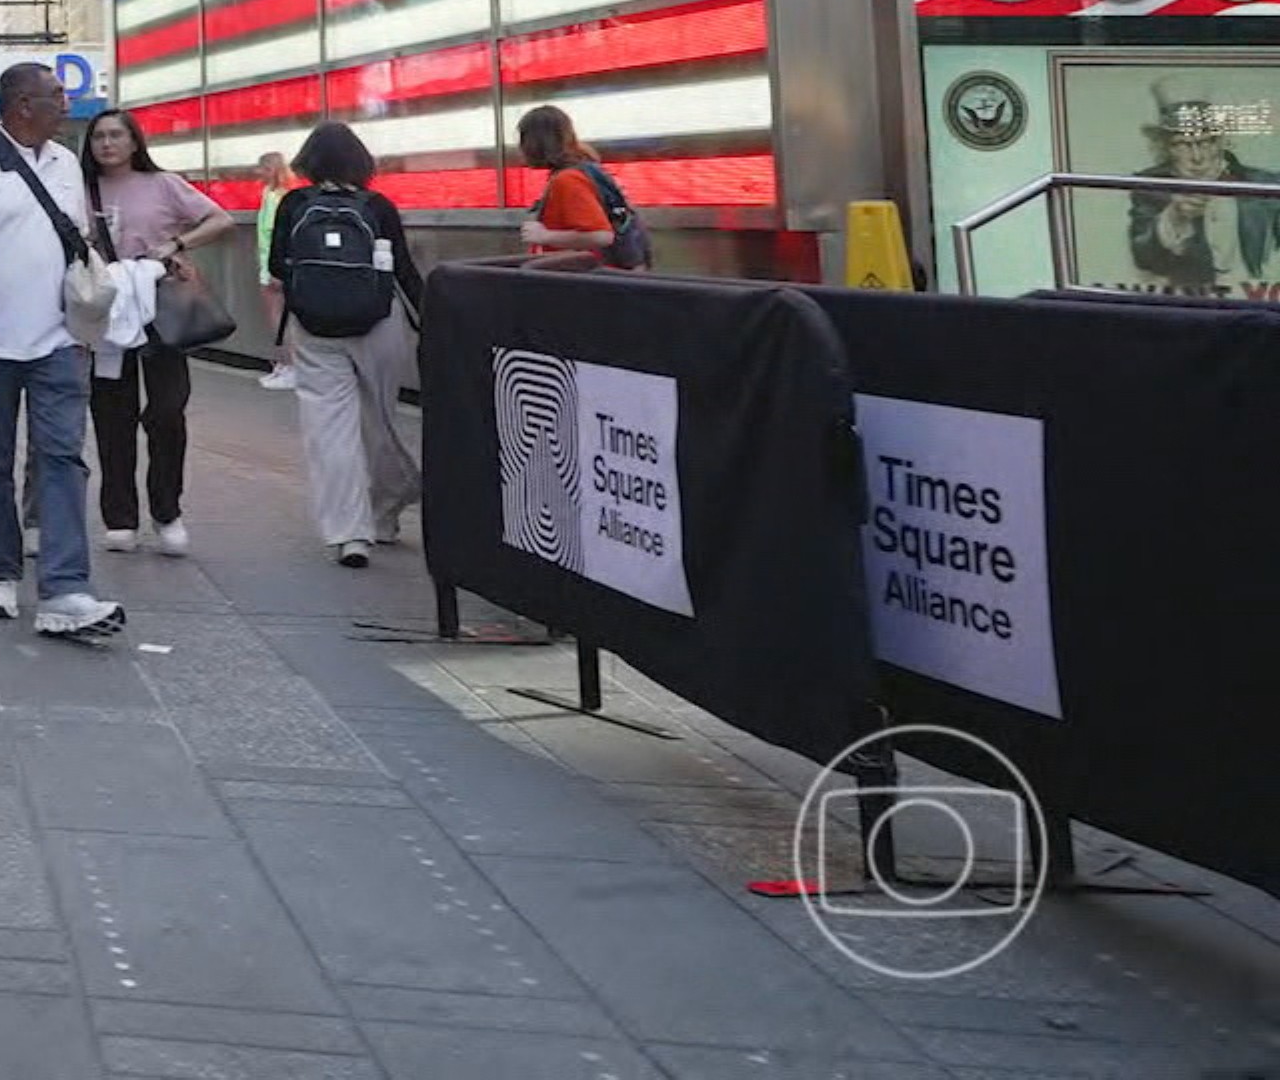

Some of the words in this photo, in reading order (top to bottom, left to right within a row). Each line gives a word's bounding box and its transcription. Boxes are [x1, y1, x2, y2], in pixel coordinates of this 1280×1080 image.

[595, 412, 658, 465] Times
[593, 454, 668, 512] Square
[878, 454, 1003, 525] Times
[597, 506, 665, 557] Alliance
[873, 505, 1016, 584] Square
[884, 571, 1013, 641] Alliance
